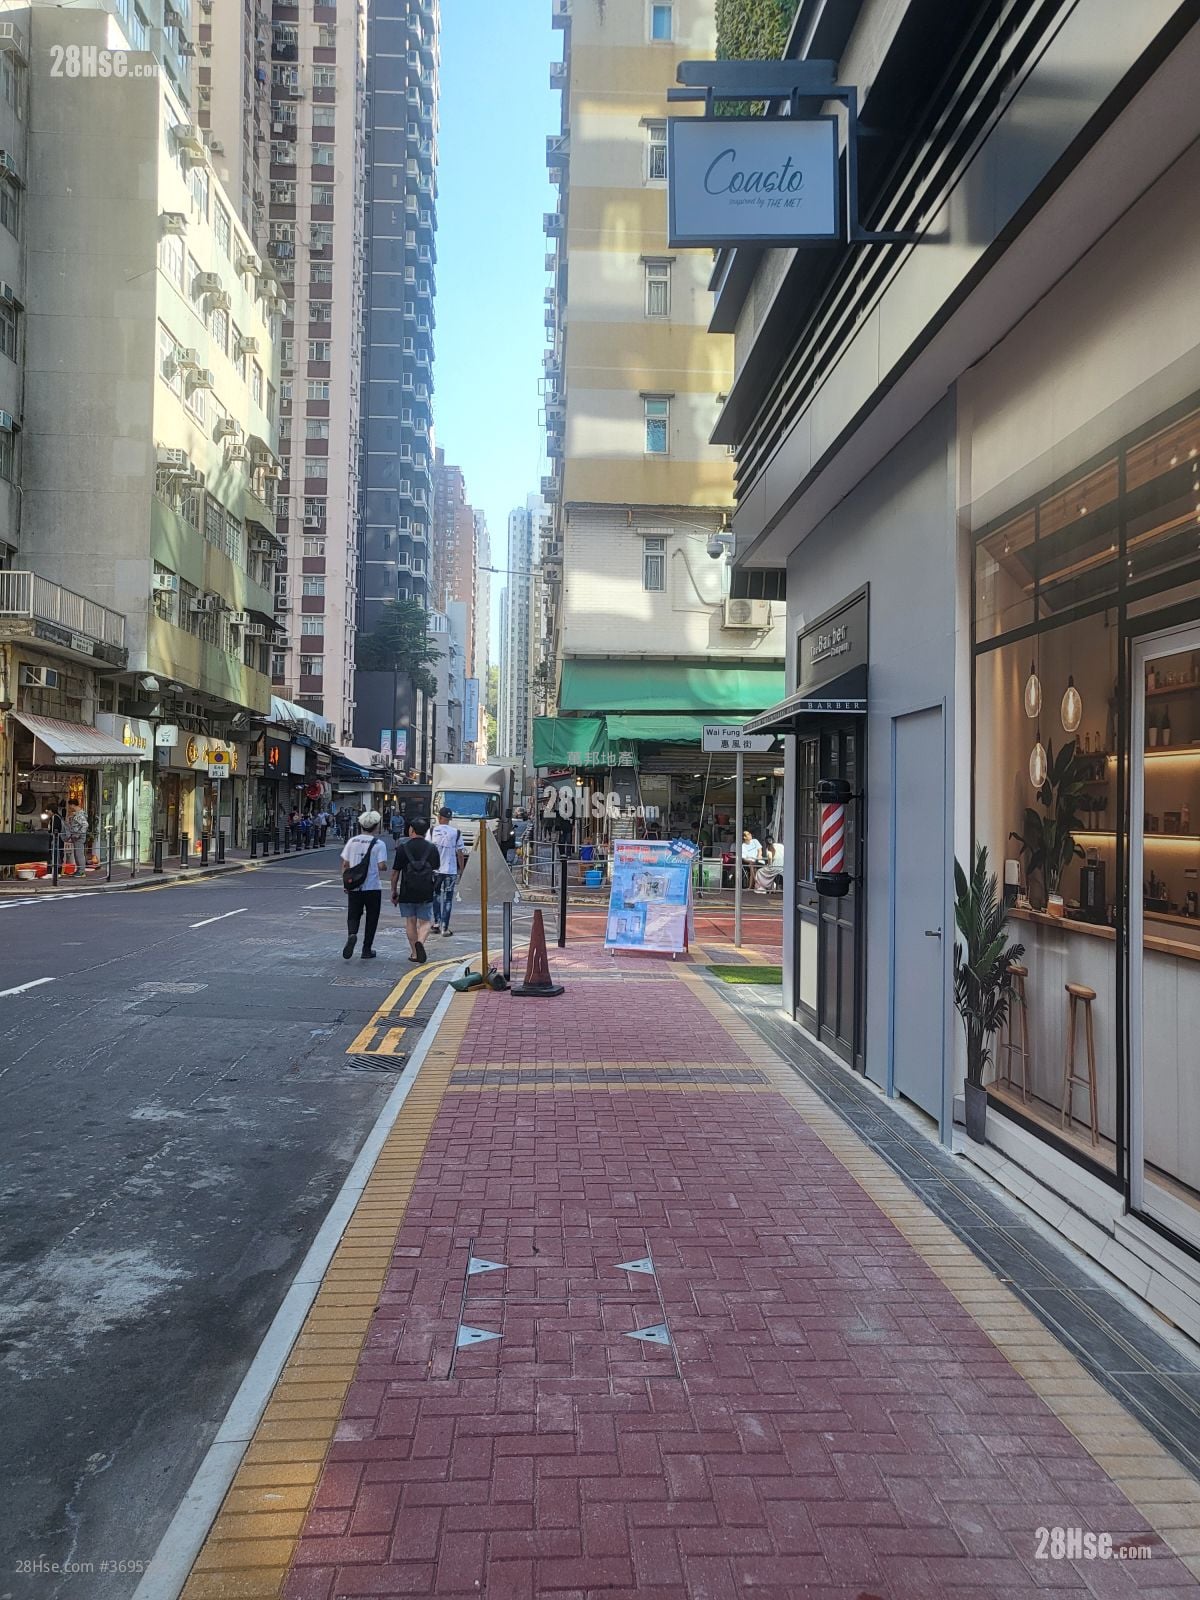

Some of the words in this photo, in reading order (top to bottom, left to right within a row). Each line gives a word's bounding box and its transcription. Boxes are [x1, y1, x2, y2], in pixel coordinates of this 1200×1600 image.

[704, 148, 804, 195] Coasto
[767, 198, 782, 208] THE
[784, 198, 802, 208] MET
[808, 702, 860, 710] BARBER
[706, 728, 720, 736] Wai
[722, 728, 740, 738] Fung
[721, 739, 752, 749] 惠風街
